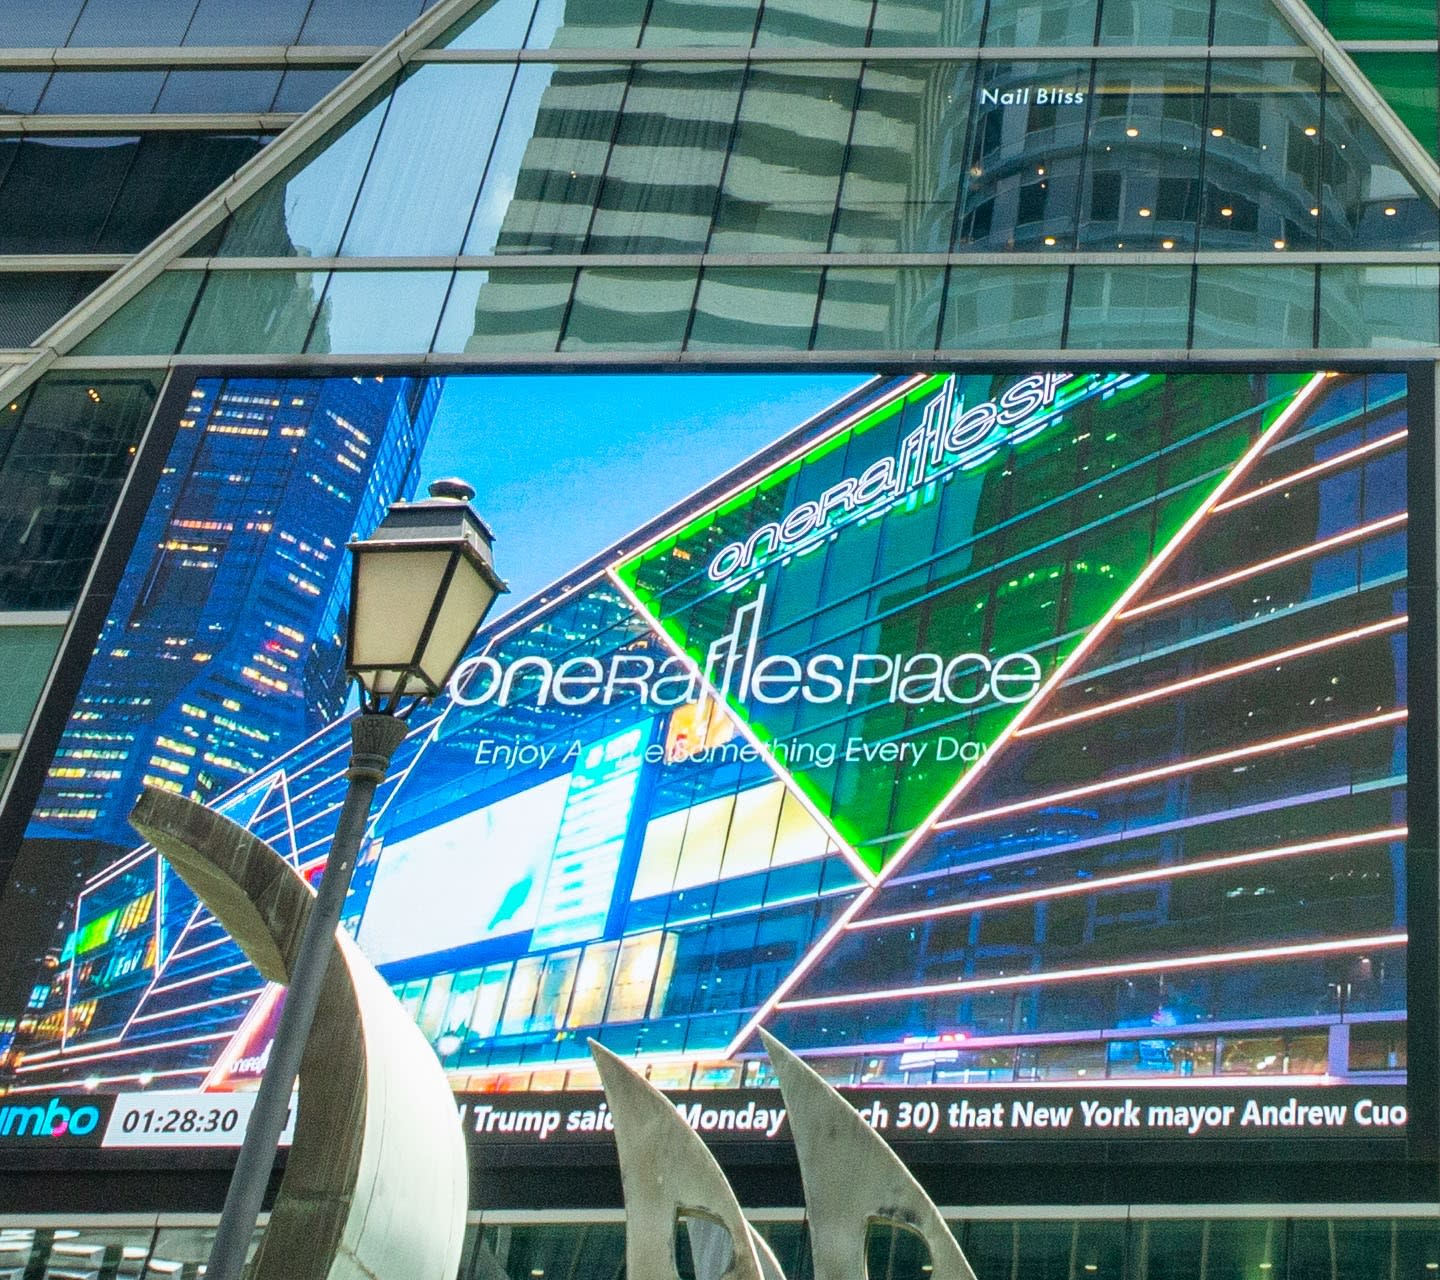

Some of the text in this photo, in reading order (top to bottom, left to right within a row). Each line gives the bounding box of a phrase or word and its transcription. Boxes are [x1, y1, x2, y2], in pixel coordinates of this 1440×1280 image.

[981, 87, 1085, 105] Nail Bliss
[474, 739, 553, 770] Enjoy
[846, 736, 927, 767] Every
[122, 1108, 239, 1133] 01:28:30
[474, 1103, 560, 1139] Trump
[676, 1101, 787, 1137] Monday
[896, 1100, 940, 1134] 30)
[948, 1100, 1004, 1128] that
[1011, 1101, 1073, 1128] New
[1081, 1099, 1141, 1128] York
[1148, 1104, 1235, 1135] mayor
[1241, 1098, 1347, 1127] Andrew
[1354, 1099, 1408, 1127] Cuo
